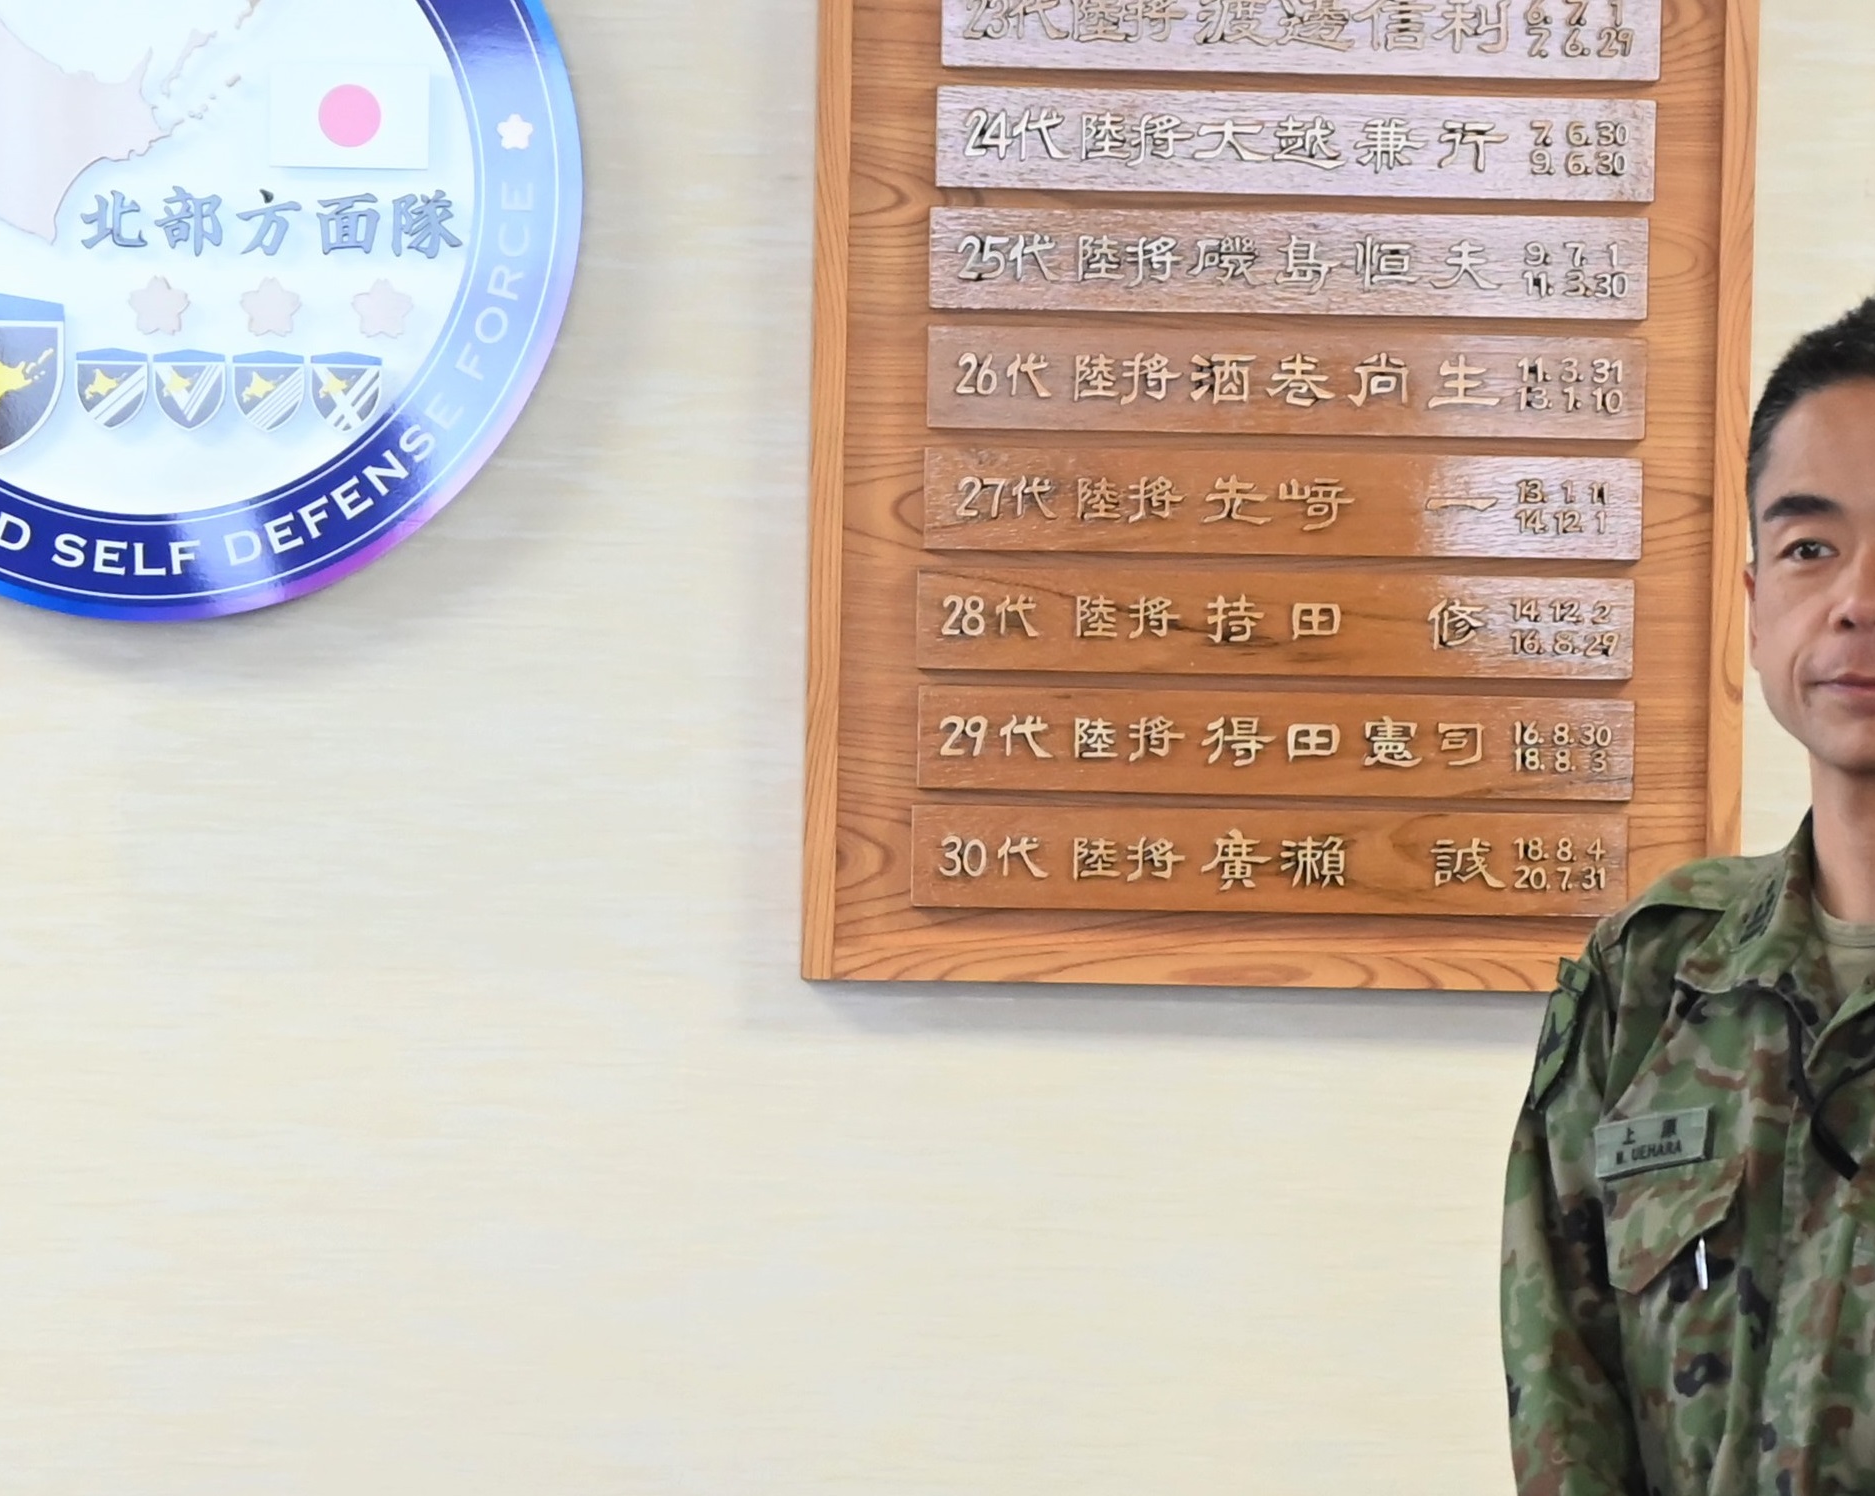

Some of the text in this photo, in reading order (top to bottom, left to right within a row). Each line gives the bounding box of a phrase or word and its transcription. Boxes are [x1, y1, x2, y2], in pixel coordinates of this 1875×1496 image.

[963, 105, 1072, 162] 24代
[79, 187, 465, 259] 北部方面隊
[957, 233, 1061, 283] 25代
[50, 531, 202, 579] SELF
[223, 396, 461, 571] DEFENSE
[455, 180, 537, 386] FORCE
[955, 351, 1052, 398] 26代
[955, 475, 1057, 520] 27代
[940, 594, 1040, 639] 28代
[938, 714, 1054, 760] 29代
[938, 835, 1049, 879] 30代
